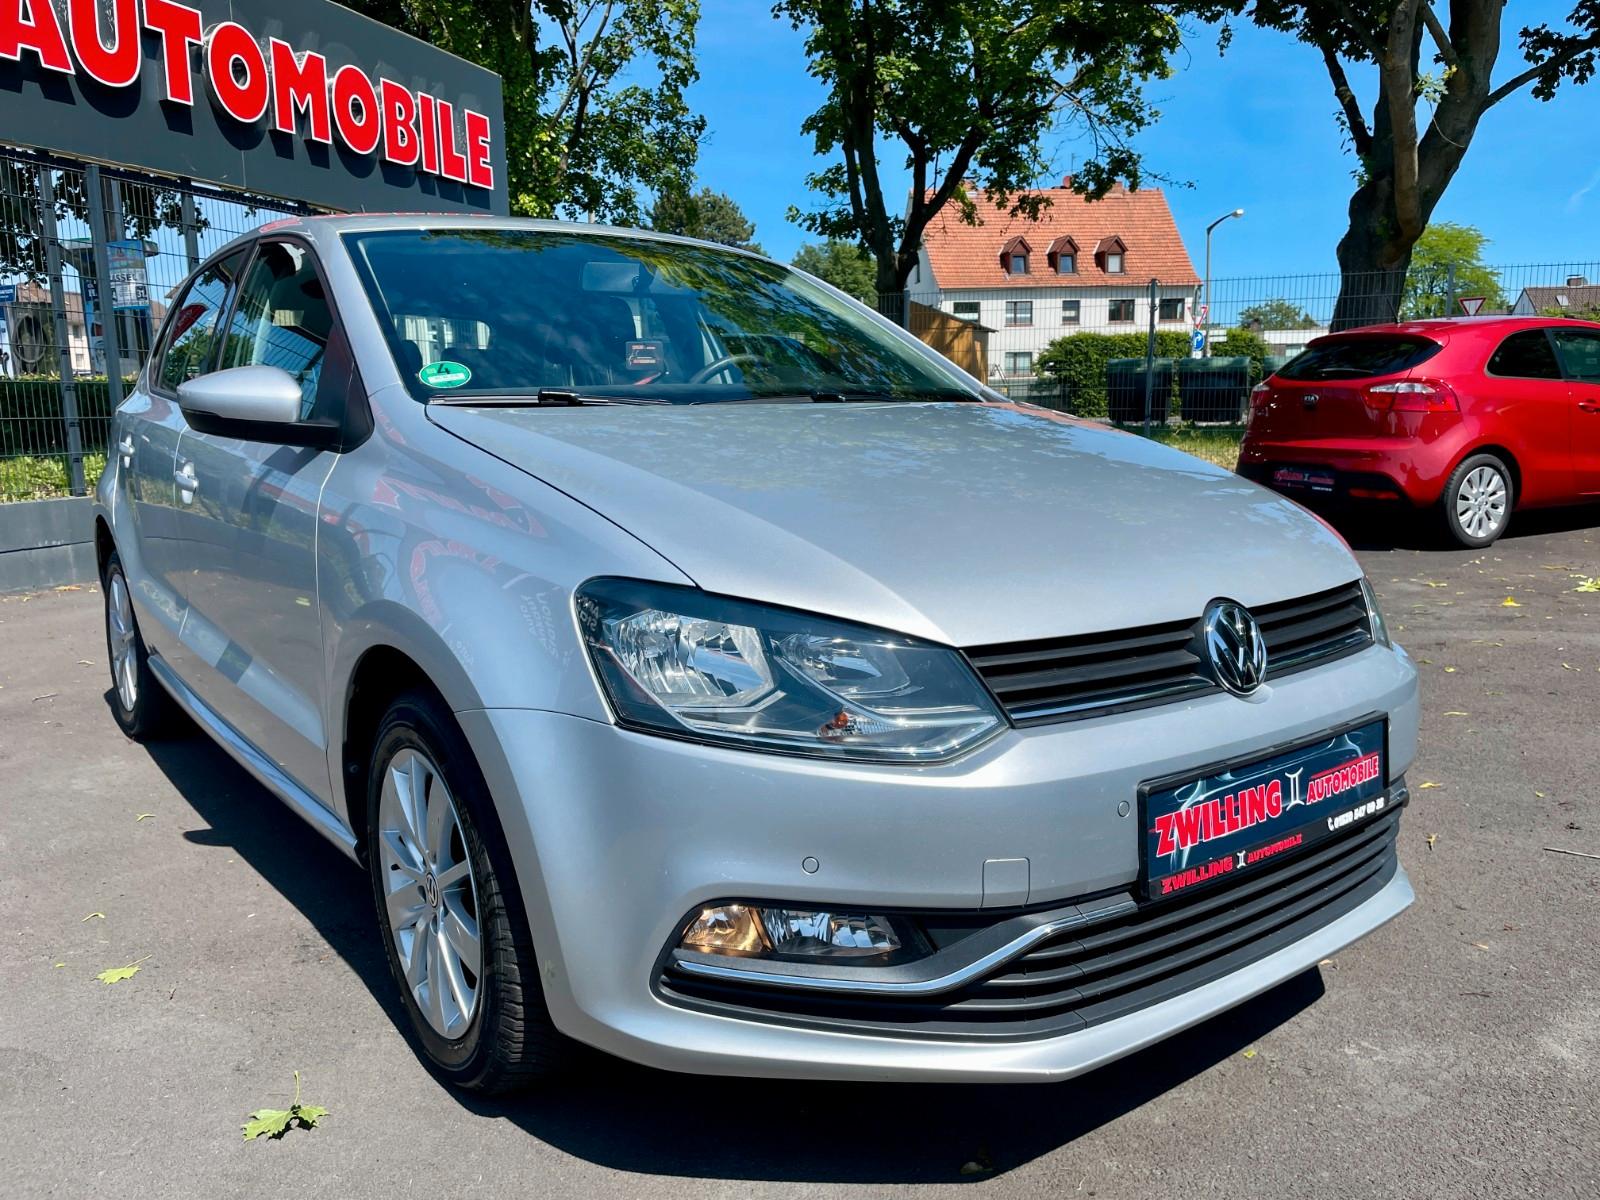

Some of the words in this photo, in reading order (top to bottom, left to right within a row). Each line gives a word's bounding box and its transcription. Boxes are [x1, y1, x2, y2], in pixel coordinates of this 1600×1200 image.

[1155, 779, 1282, 858] ZWILLING
[1306, 755, 1379, 806] AUTOMOBILE
[1161, 856, 1233, 894] ZWILLING
